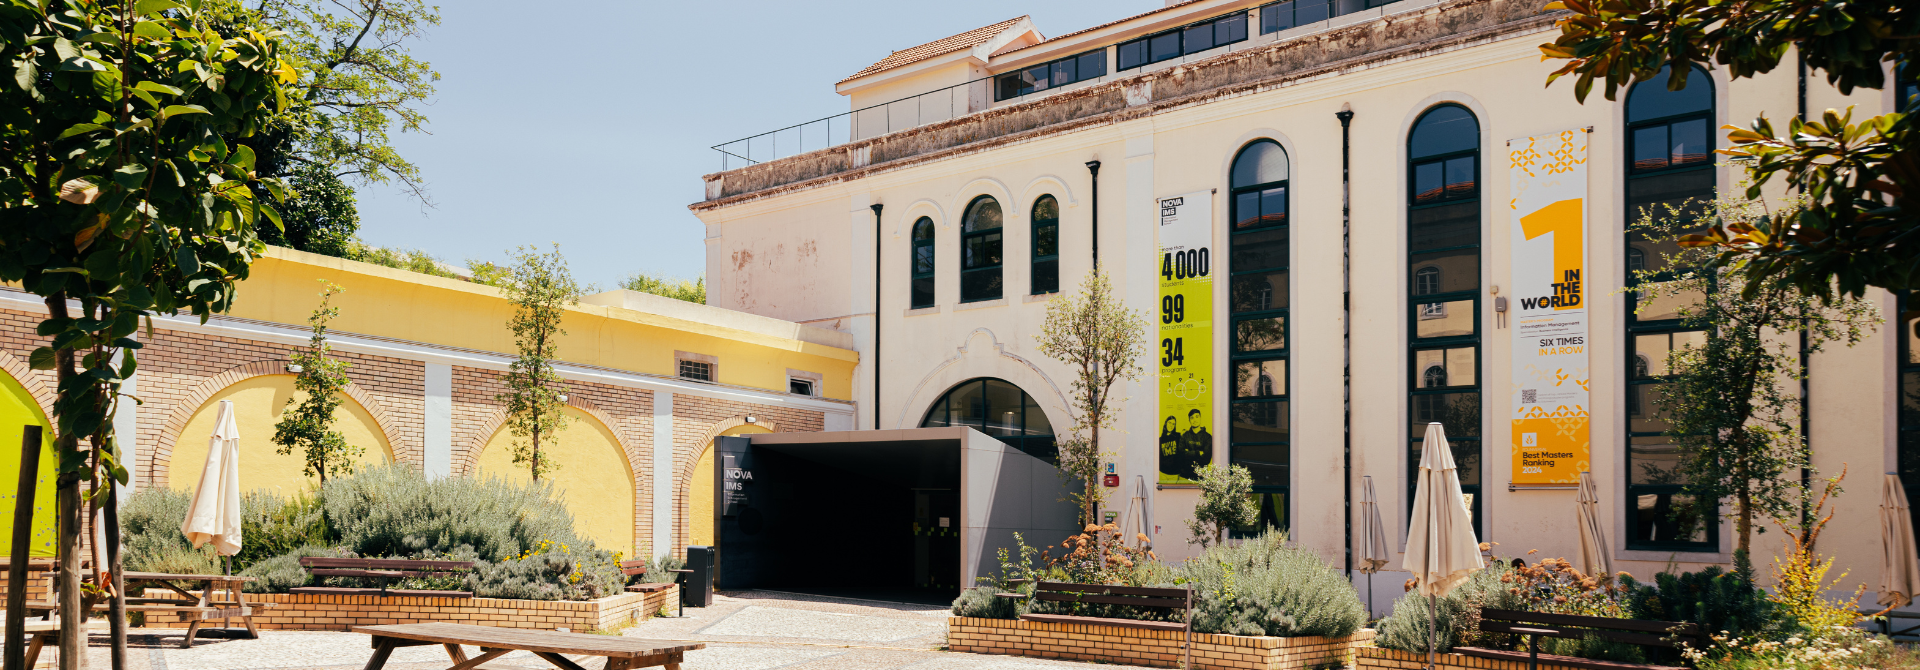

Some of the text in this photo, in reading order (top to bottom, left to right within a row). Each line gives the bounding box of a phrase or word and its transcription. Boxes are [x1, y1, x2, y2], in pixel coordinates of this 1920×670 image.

[1162, 198, 1182, 208] NOVA
[1162, 208, 1175, 216] IMS
[1519, 198, 1583, 311] 1
[1564, 269, 1580, 282] IN
[1551, 281, 1580, 295] THE
[1520, 294, 1580, 310] WORLD
[1162, 294, 1184, 324] 99
[1540, 337, 1584, 347] SIX TIMES
[1162, 337, 1184, 367] 34
[1539, 348, 1548, 356] IN
[1559, 346, 1584, 355] ROW
[1522, 459, 1555, 467] Ranking
[726, 470, 753, 479] NOVA
[1522, 466, 1542, 474] 2024
[726, 482, 742, 490] IMS
